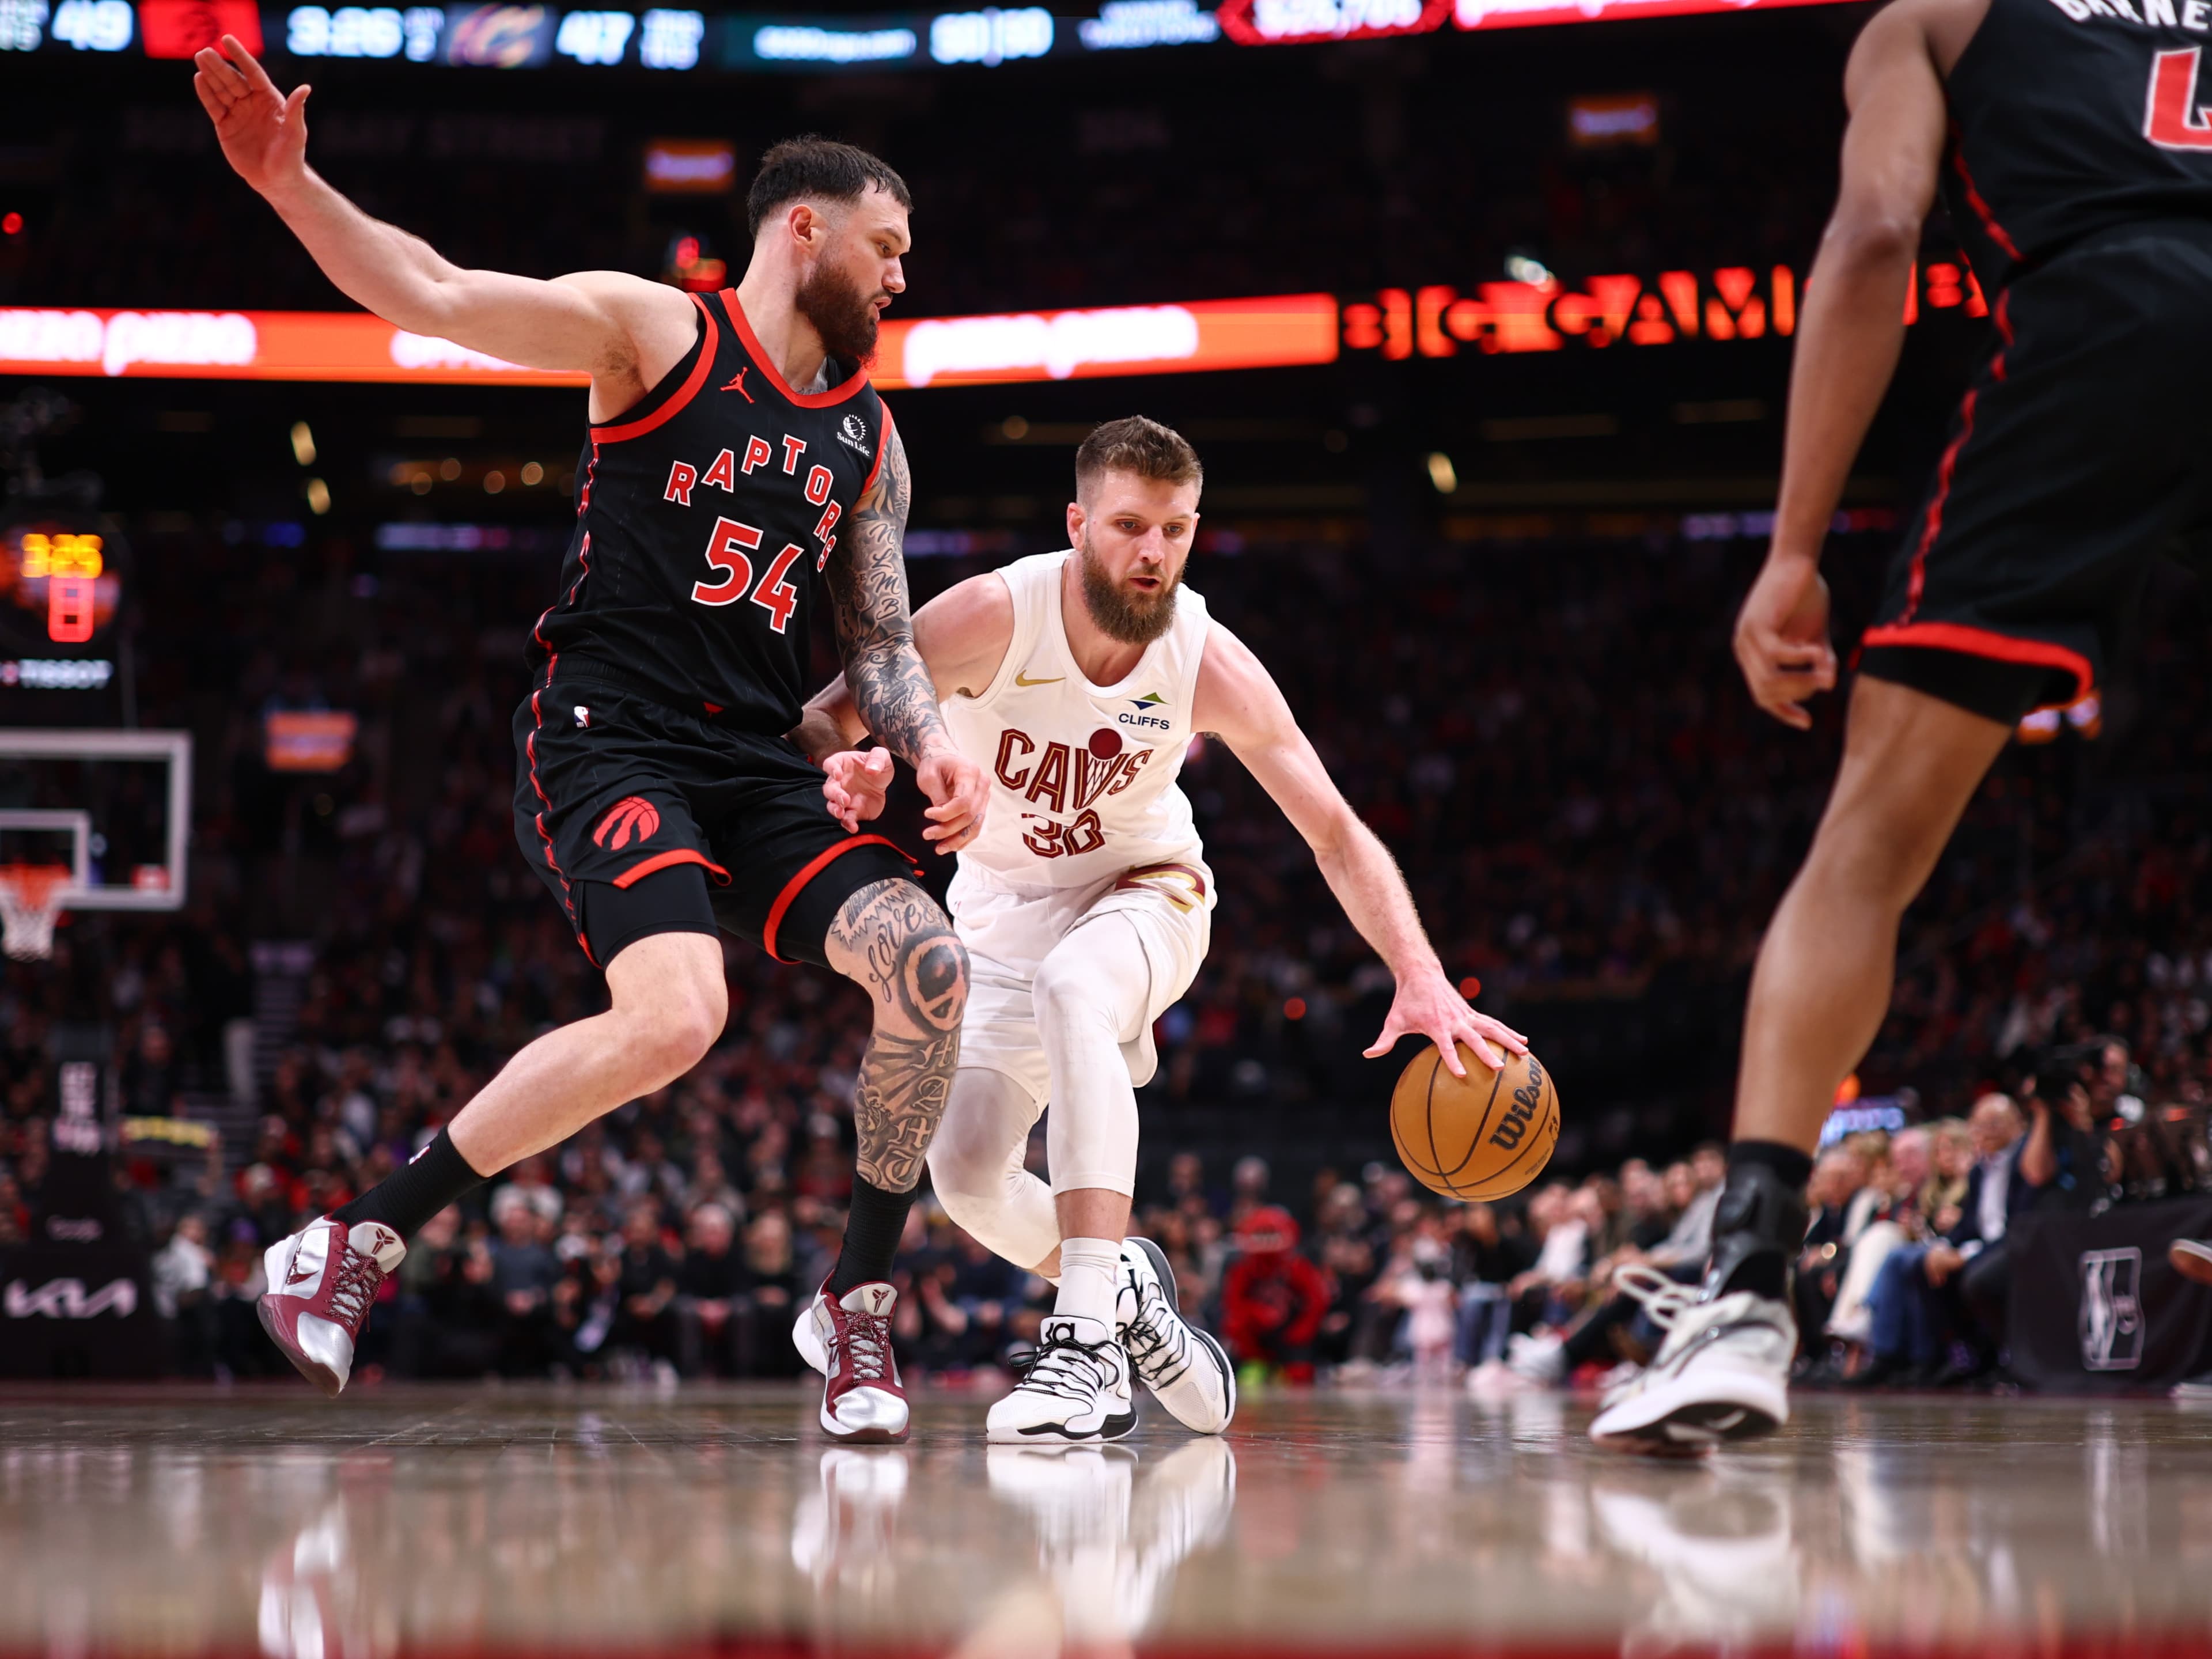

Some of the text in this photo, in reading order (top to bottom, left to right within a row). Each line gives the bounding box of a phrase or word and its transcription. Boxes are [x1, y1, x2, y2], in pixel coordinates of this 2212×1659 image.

[2049, 0, 2212, 30] BARNE
[837, 431, 870, 456] Sun Life
[664, 433, 842, 573] RAPTORS
[691, 516, 805, 635] 54
[1118, 713, 1170, 730] CLIFFS
[994, 728, 1154, 813] CAVS
[1488, 1054, 1542, 1150] Wilson
